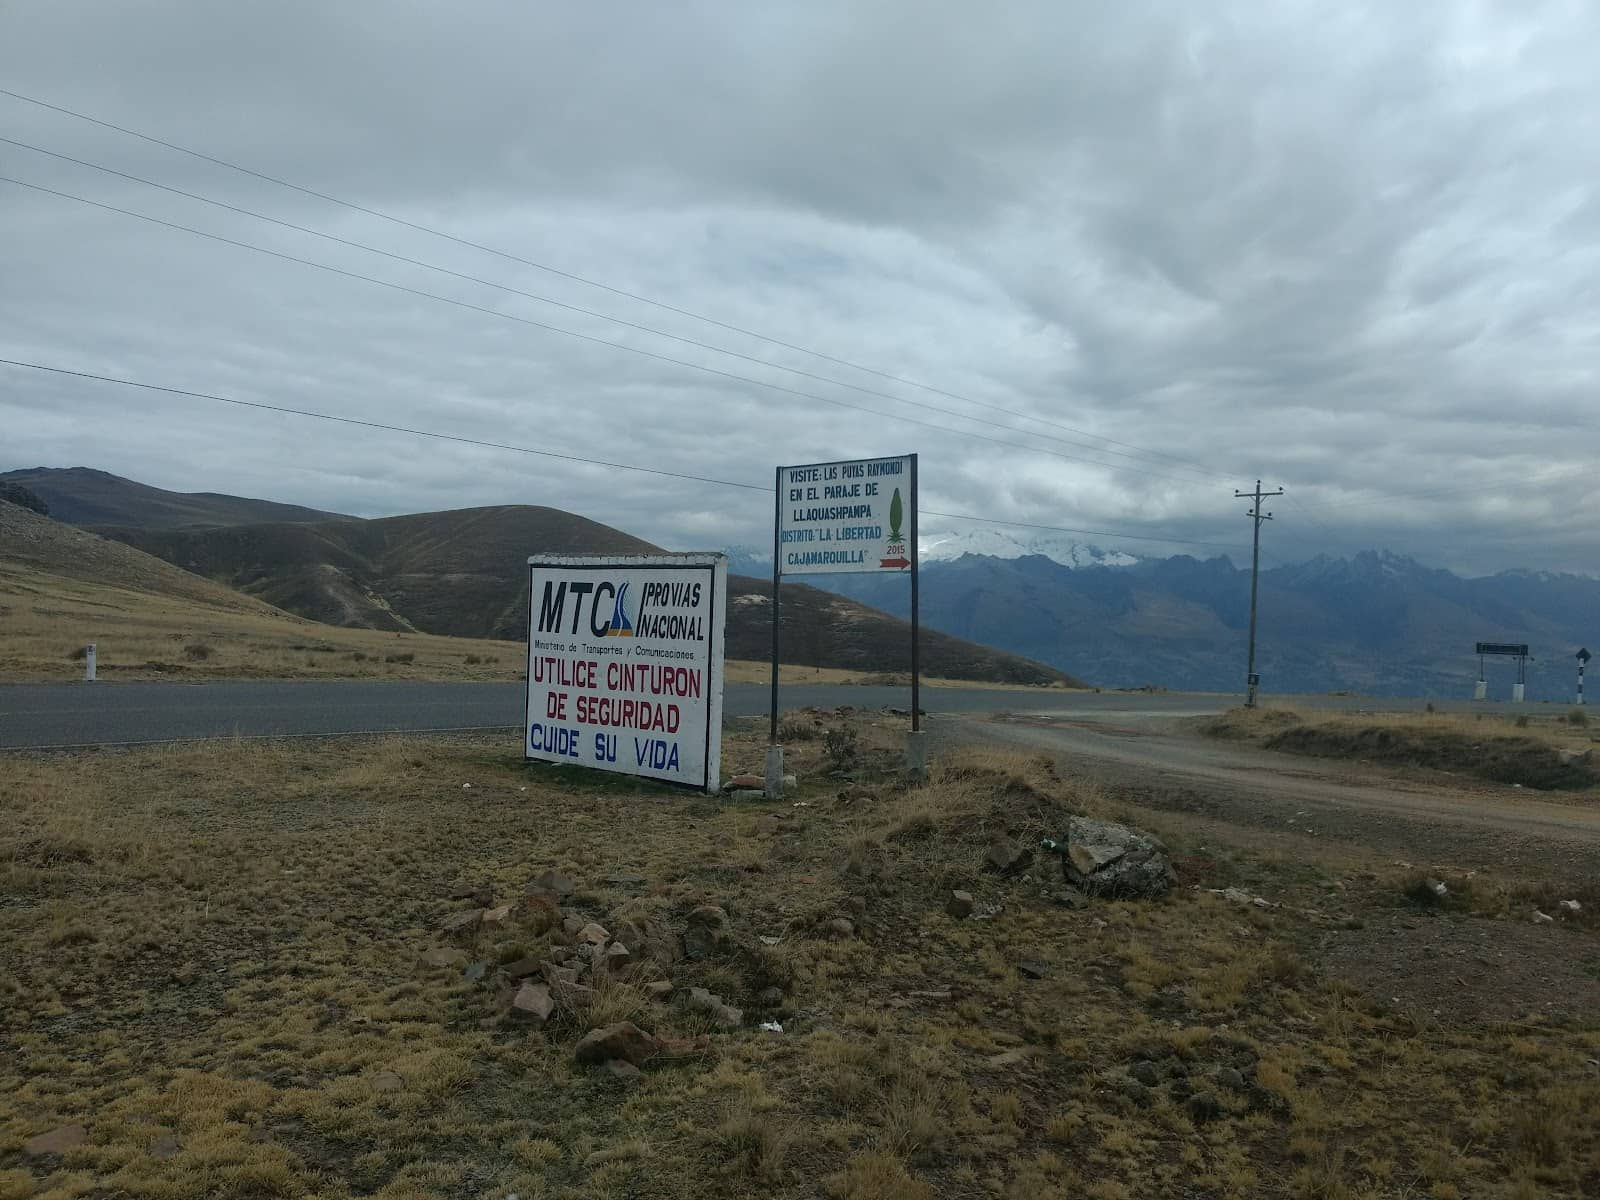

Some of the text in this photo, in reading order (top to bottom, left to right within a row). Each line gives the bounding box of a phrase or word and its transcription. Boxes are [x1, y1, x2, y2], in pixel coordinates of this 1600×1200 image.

[790, 461, 902, 483] VISITE: LAS PUYAS RAYMONDI
[790, 483, 878, 501] EN EL PARAJE DE
[794, 504, 871, 522] LLAQUASHPAMPA
[836, 526, 881, 540] LIBERTAD
[887, 546, 905, 554] 2015
[645, 582, 701, 608] PROVIAS
[539, 581, 615, 637] MTC
[641, 615, 703, 641] NACIONAL
[535, 640, 565, 652] Ministerio
[569, 643, 577, 653] de
[582, 644, 623, 656] Transportes
[627, 648, 631, 656] y
[534, 657, 701, 698] UTILICE CINTURON
[547, 692, 680, 733] DE SEGURIDAD
[531, 723, 679, 772] CUIDE SU VIDA
